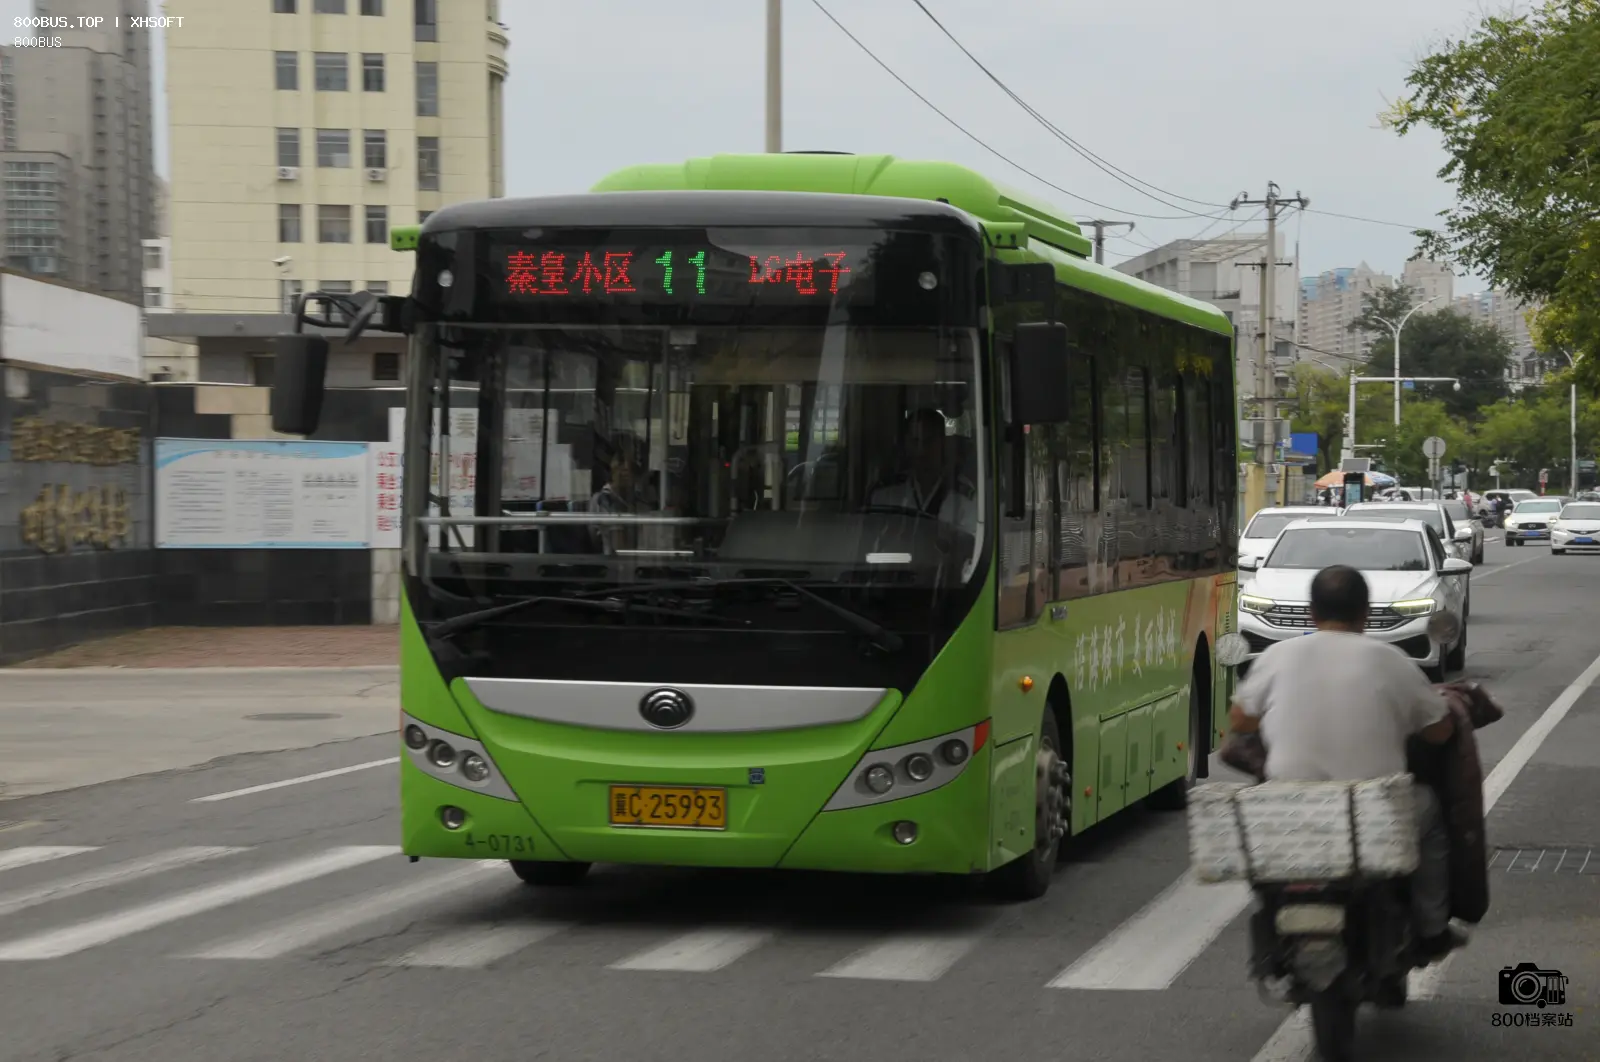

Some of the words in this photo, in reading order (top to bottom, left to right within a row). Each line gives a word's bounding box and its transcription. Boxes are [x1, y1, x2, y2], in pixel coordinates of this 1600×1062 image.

[504, 250, 637, 295] 秦皇小区
[655, 250, 707, 295] 11
[748, 250, 852, 295] LG电子
[463, 833, 535, 854] 4-0731
